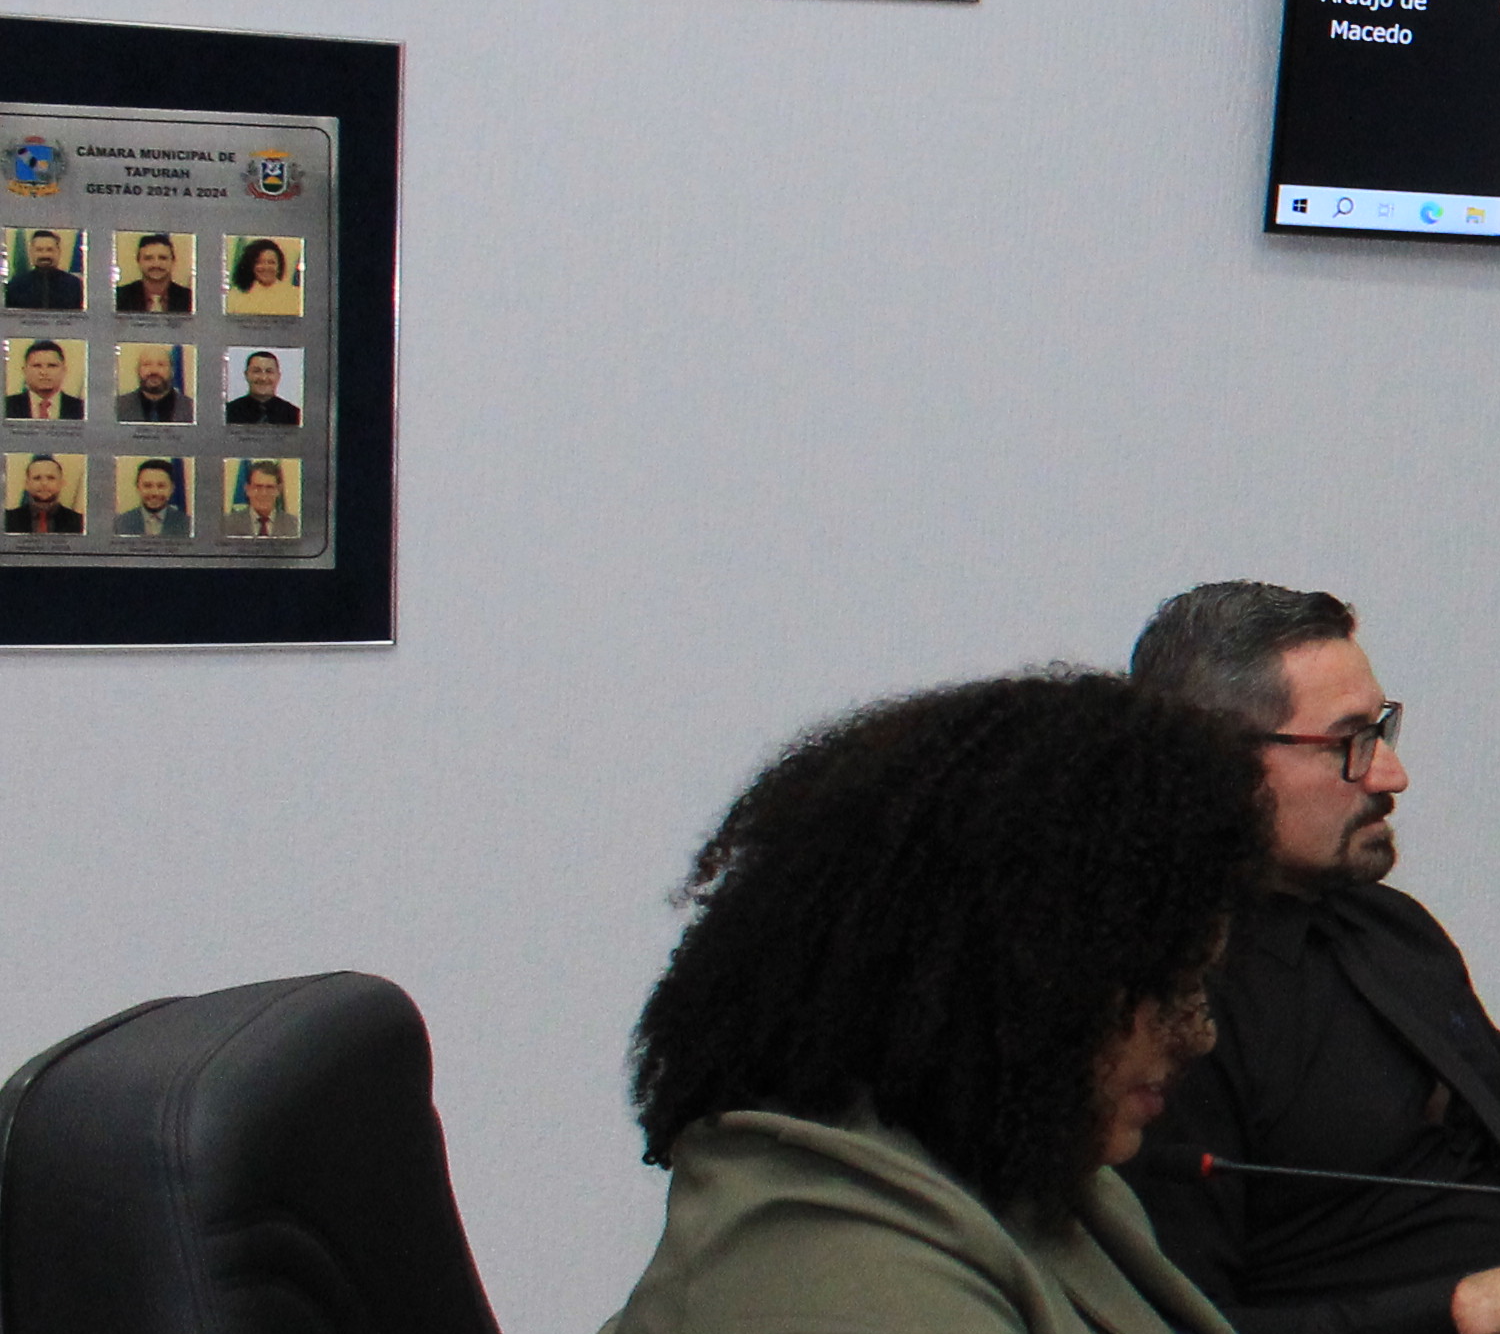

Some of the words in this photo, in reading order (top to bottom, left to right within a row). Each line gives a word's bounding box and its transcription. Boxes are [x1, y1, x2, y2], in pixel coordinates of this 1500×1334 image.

[1330, 19, 1413, 45] Macedo
[77, 144, 136, 158] CÂMARA
[140, 148, 215, 163] MUNICIPAL
[218, 152, 237, 163] DE
[125, 166, 190, 179] TAPURAH
[86, 182, 143, 196] GESTÃO
[183, 187, 193, 198] A
[196, 188, 228, 198] 2024
